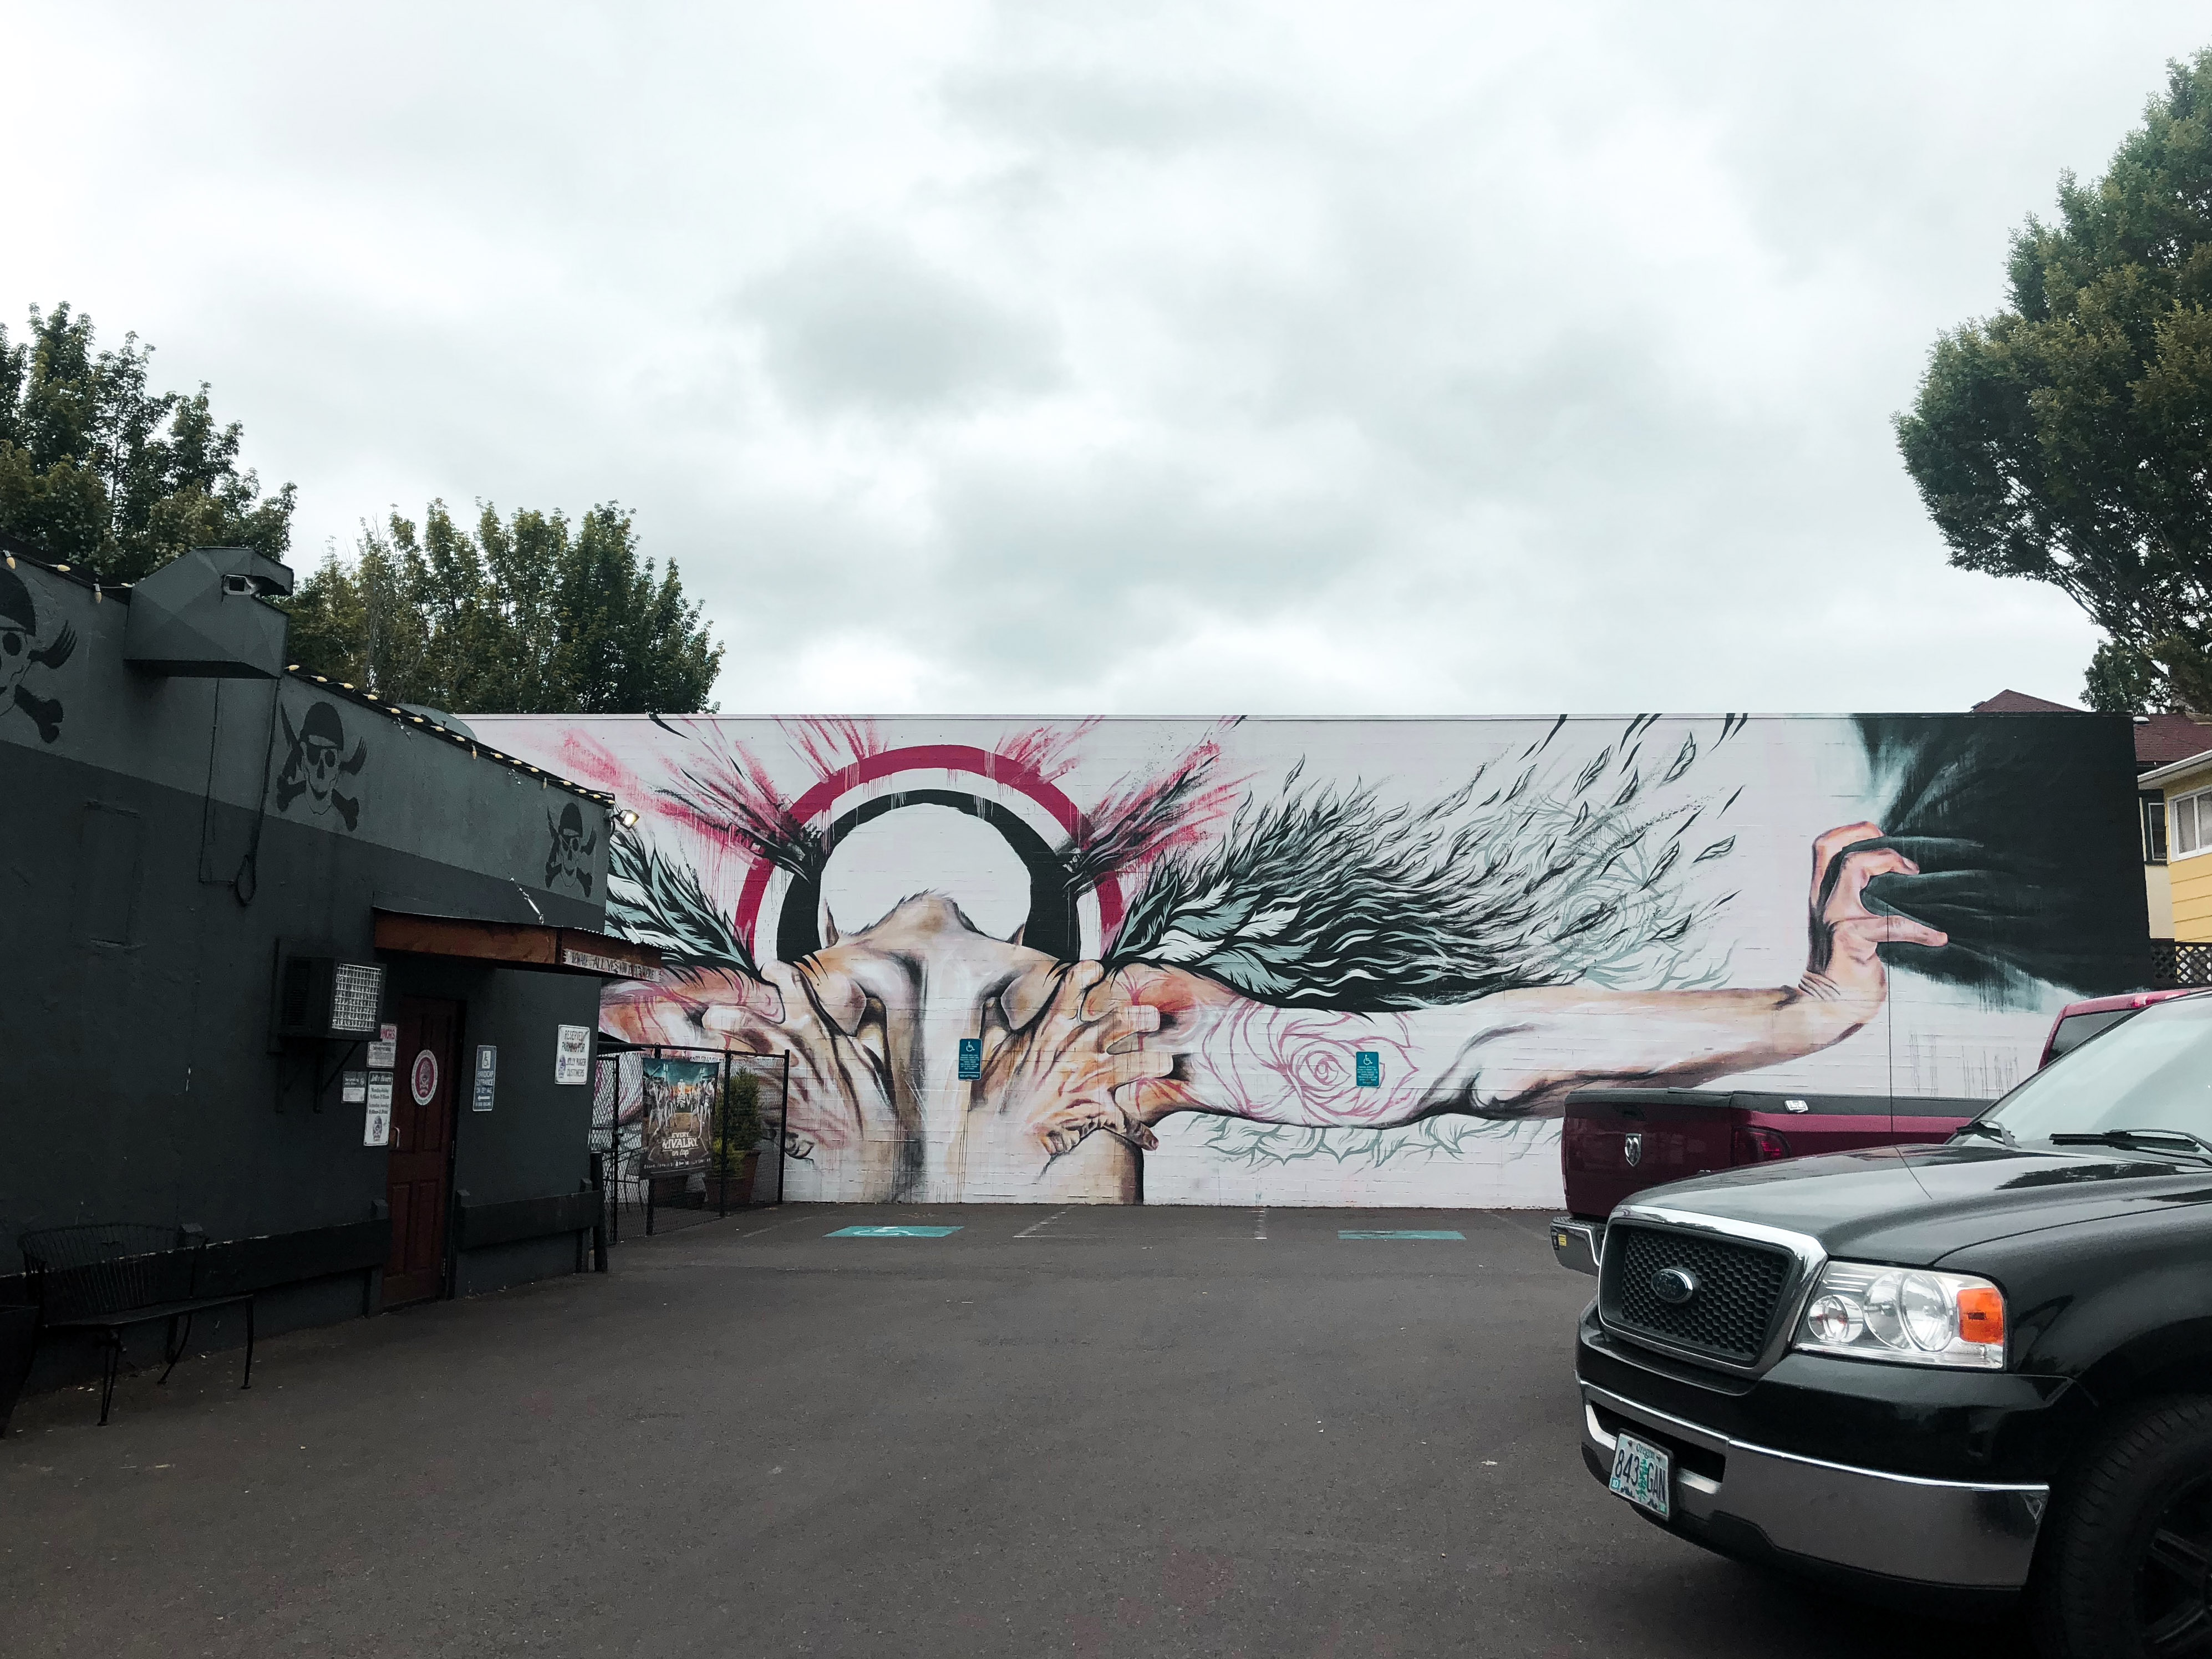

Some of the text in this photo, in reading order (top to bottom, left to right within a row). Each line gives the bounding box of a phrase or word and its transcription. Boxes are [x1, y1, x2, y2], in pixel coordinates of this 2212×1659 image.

[572, 952, 588, 966] BEWARE
[593, 956, 604, 969] ALL
[642, 966, 655, 980] HERE
[565, 1030, 584, 1041] RESERVED
[562, 1042, 577, 1052] PARKING
[566, 1057, 576, 1066] JOLLY
[567, 1068, 584, 1077] CUSTOMERS
[662, 1137, 699, 1150] RIVALRY
[1615, 1449, 1666, 1501] 843 GAN
